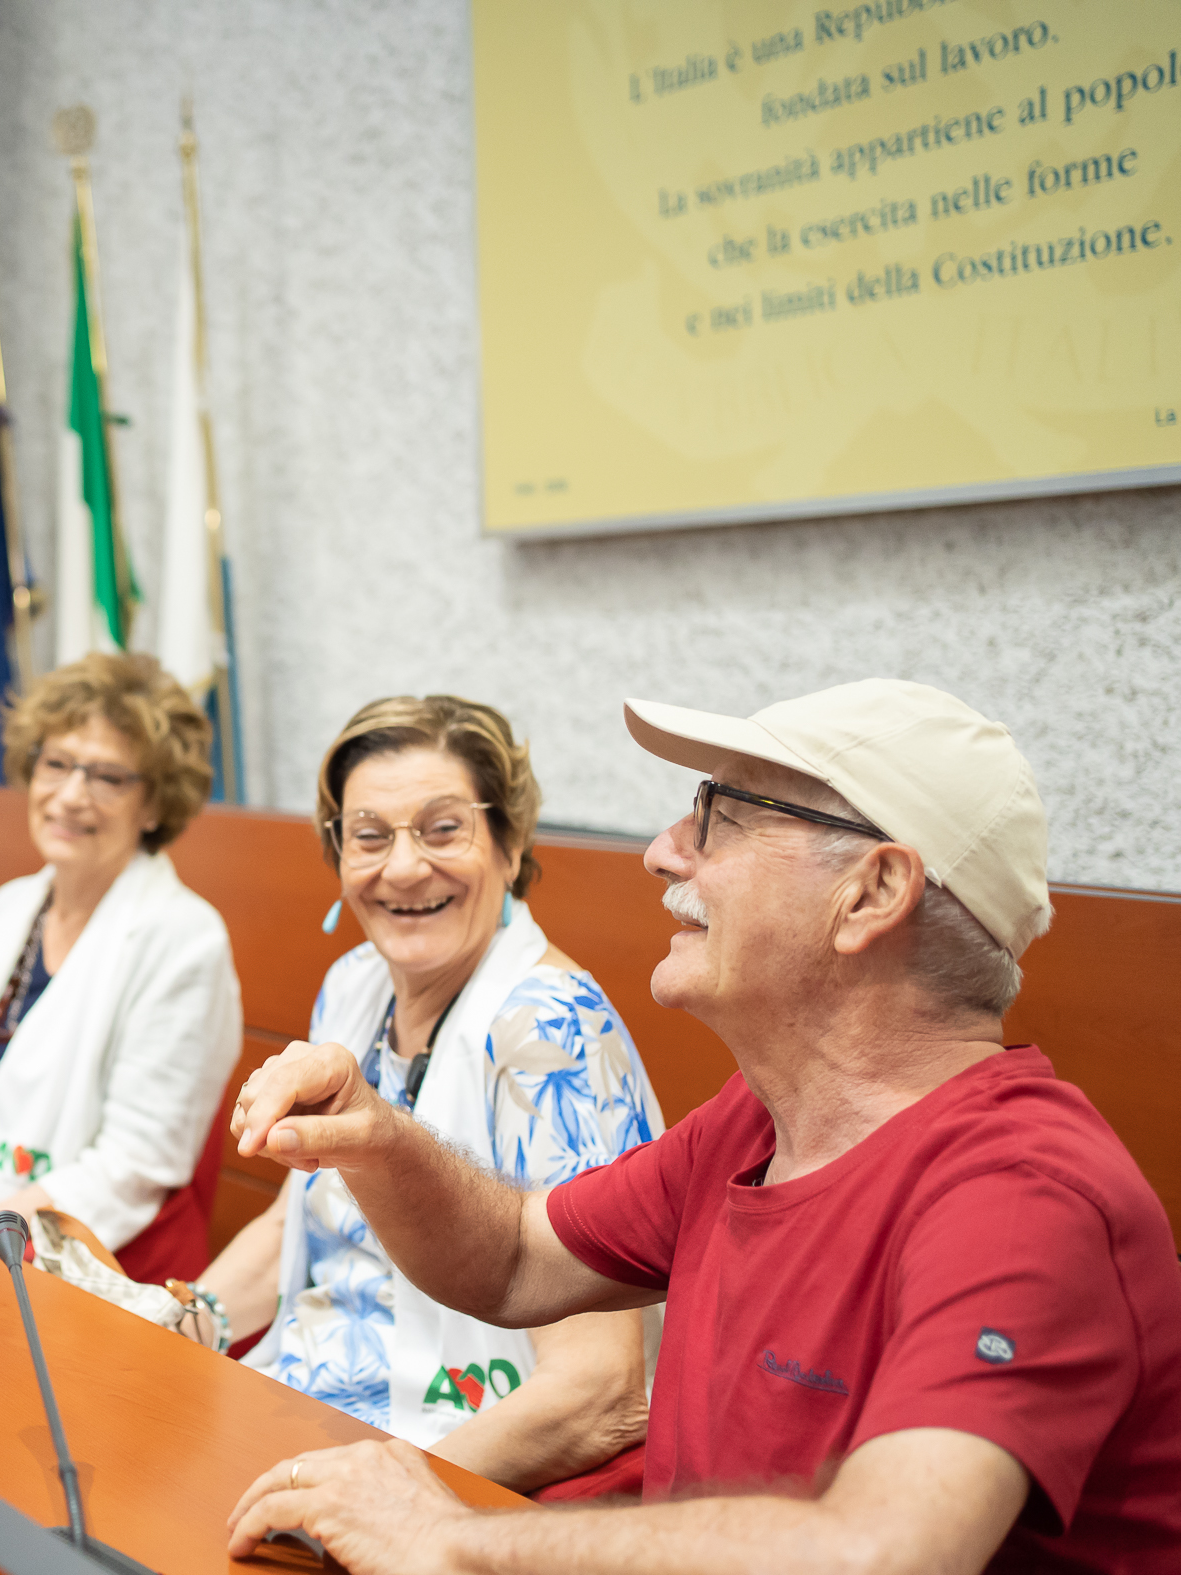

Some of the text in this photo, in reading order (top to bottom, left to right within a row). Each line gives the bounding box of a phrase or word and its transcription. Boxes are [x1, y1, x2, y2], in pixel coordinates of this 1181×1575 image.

[751, 26, 804, 66] una
[761, 19, 1060, 129] fondata sul lavoro.
[658, 47, 1181, 220] La sovranità appartiene al popol
[707, 147, 1139, 270] che la esercita nelle forme
[685, 219, 1171, 337] e nei limiti della Costituzione.
